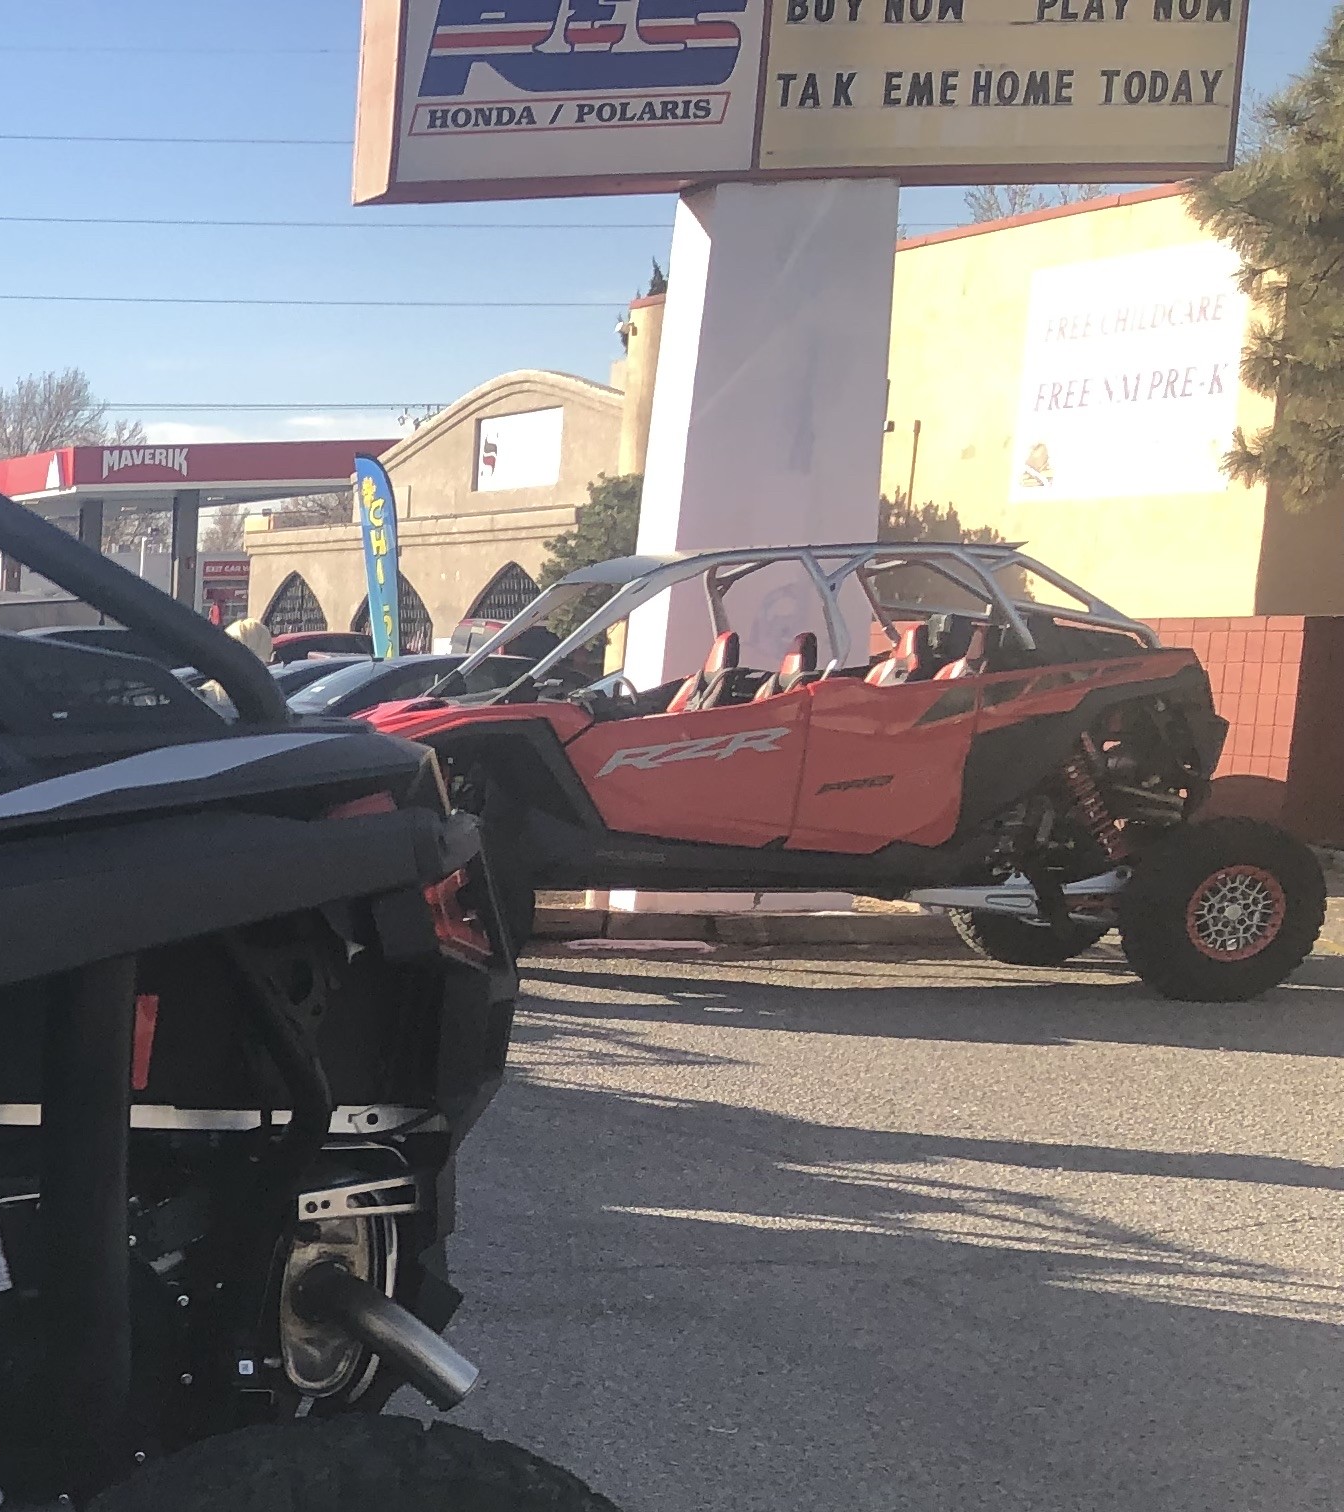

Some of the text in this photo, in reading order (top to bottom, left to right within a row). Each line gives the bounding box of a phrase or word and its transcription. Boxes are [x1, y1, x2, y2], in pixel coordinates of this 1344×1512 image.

[787, 0, 1231, 23] BUY NOW PLAY NOW
[1100, 70, 1224, 105] TODAY
[427, 105, 537, 129] HONDA
[575, 99, 712, 123] POLARIS
[1045, 294, 1226, 342] FREE CHILDCARE
[1034, 379, 1094, 411] FREE
[1148, 363, 1229, 400] PRE-K
[102, 447, 189, 479] MAVERIK
[593, 727, 791, 779] RZR
